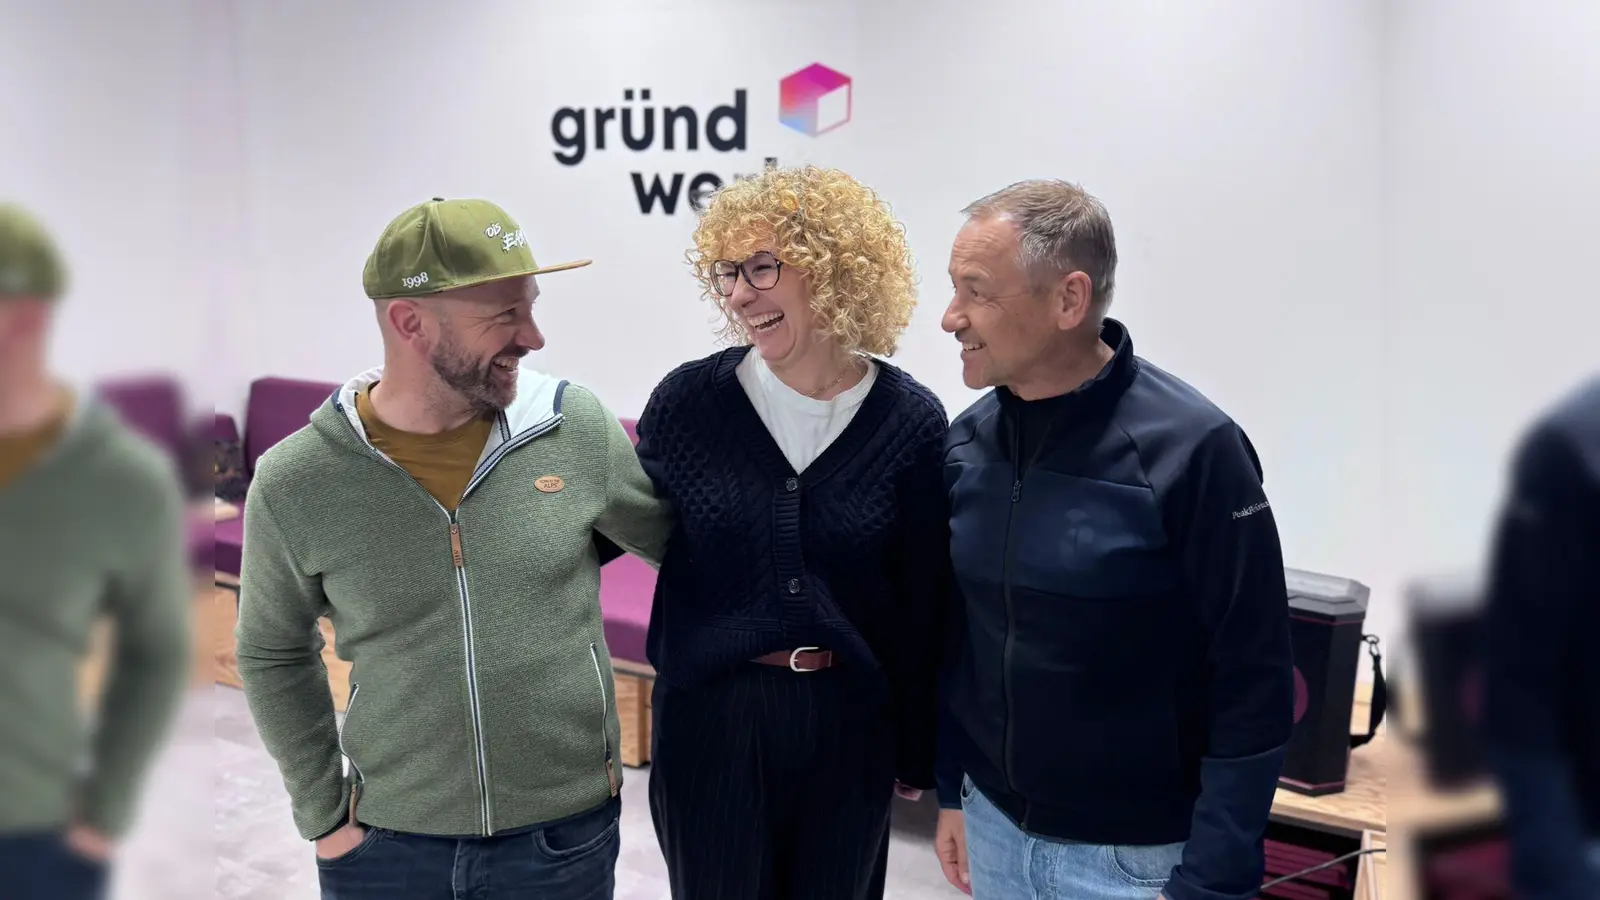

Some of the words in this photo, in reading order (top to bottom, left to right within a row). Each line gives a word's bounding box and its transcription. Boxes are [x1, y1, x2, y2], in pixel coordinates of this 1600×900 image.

[551, 88, 748, 167] gründ
[631, 157, 778, 215] we
[401, 271, 429, 289] 1998
